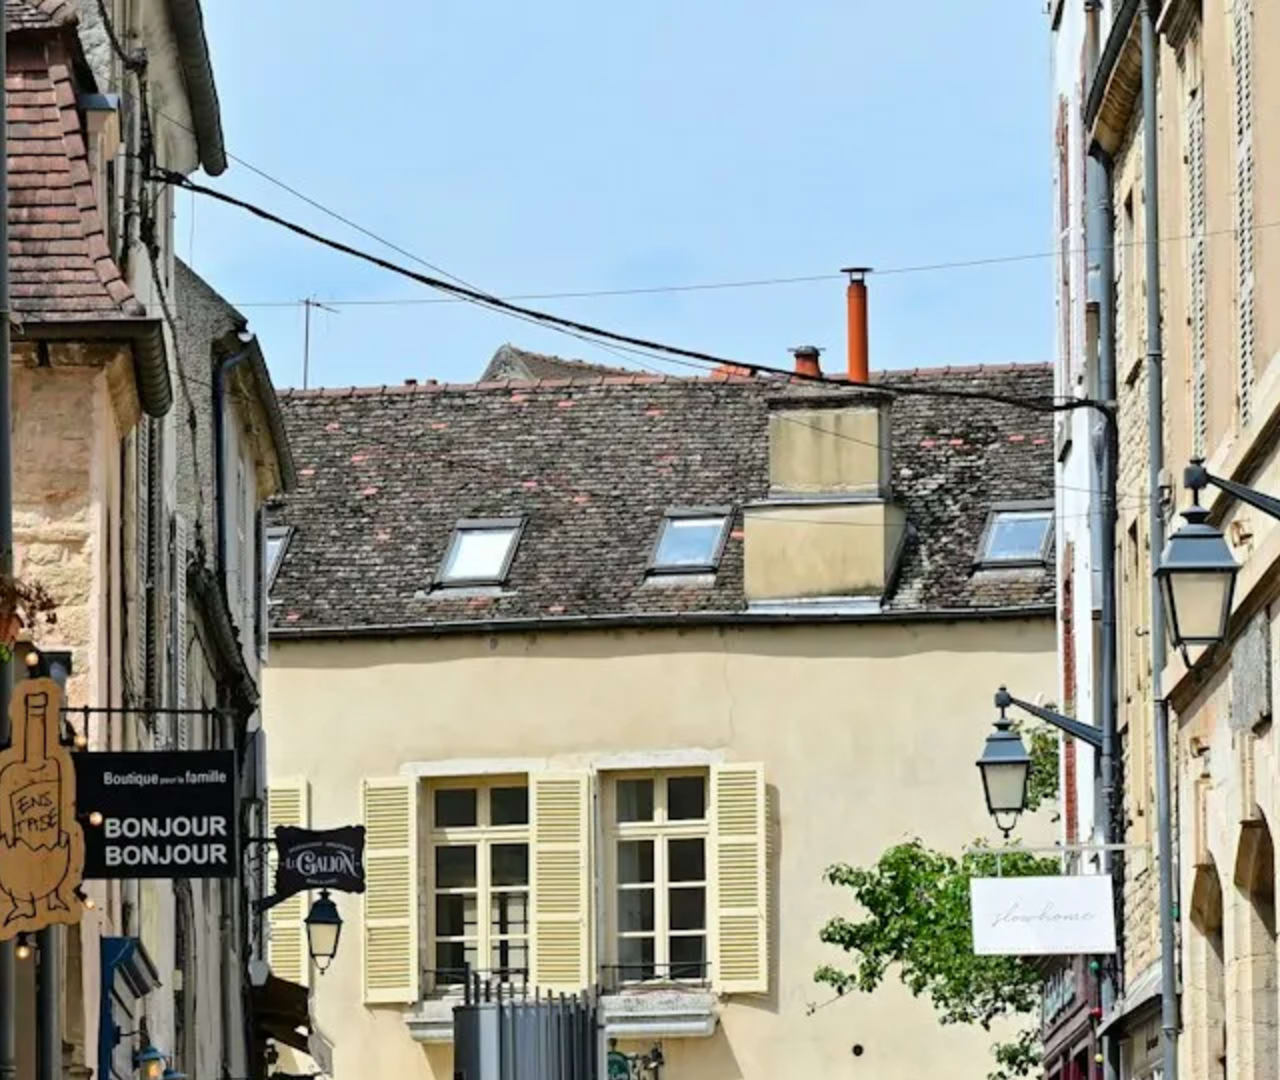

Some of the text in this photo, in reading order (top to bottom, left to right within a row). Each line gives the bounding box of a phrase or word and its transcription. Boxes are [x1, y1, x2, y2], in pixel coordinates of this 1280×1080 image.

[103, 771, 159, 787] Boutique
[185, 769, 227, 784] famille
[104, 815, 227, 839] BONJOUR
[105, 843, 228, 867] BONJOUR
